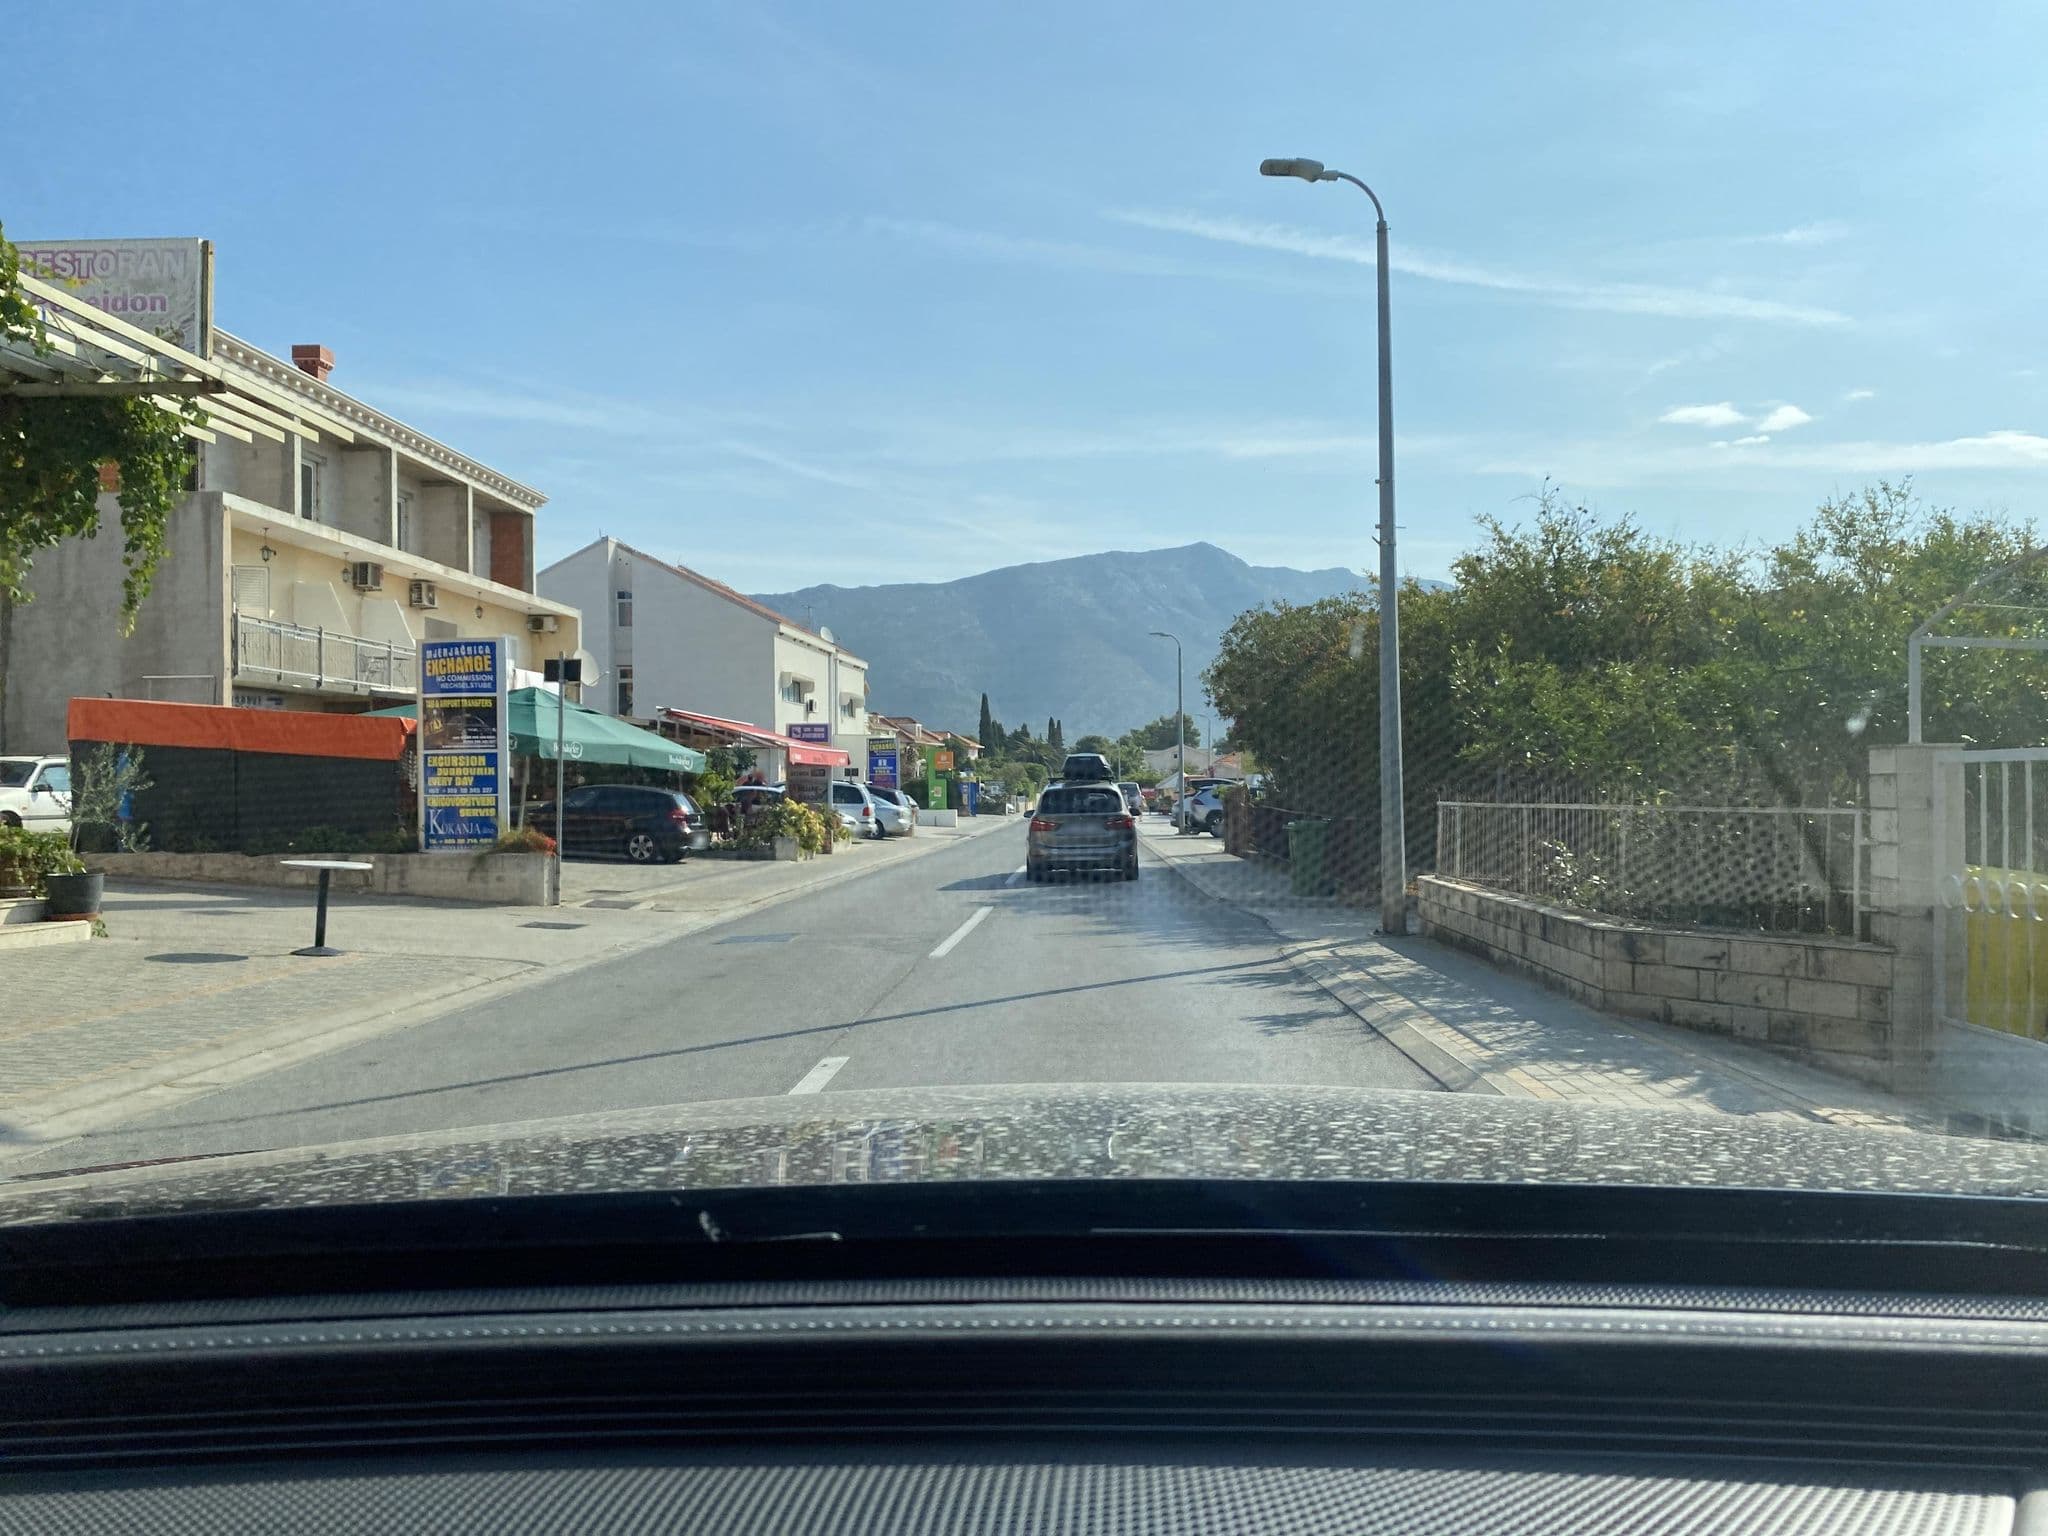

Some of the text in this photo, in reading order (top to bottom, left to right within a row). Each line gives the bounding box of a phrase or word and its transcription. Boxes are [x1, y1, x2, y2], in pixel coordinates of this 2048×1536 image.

[426, 655, 492, 676] EXCHANGE
[447, 674, 493, 682] COMMISSION
[428, 755, 486, 766] EXCURSION
[428, 776, 474, 786] EVERY DAY
